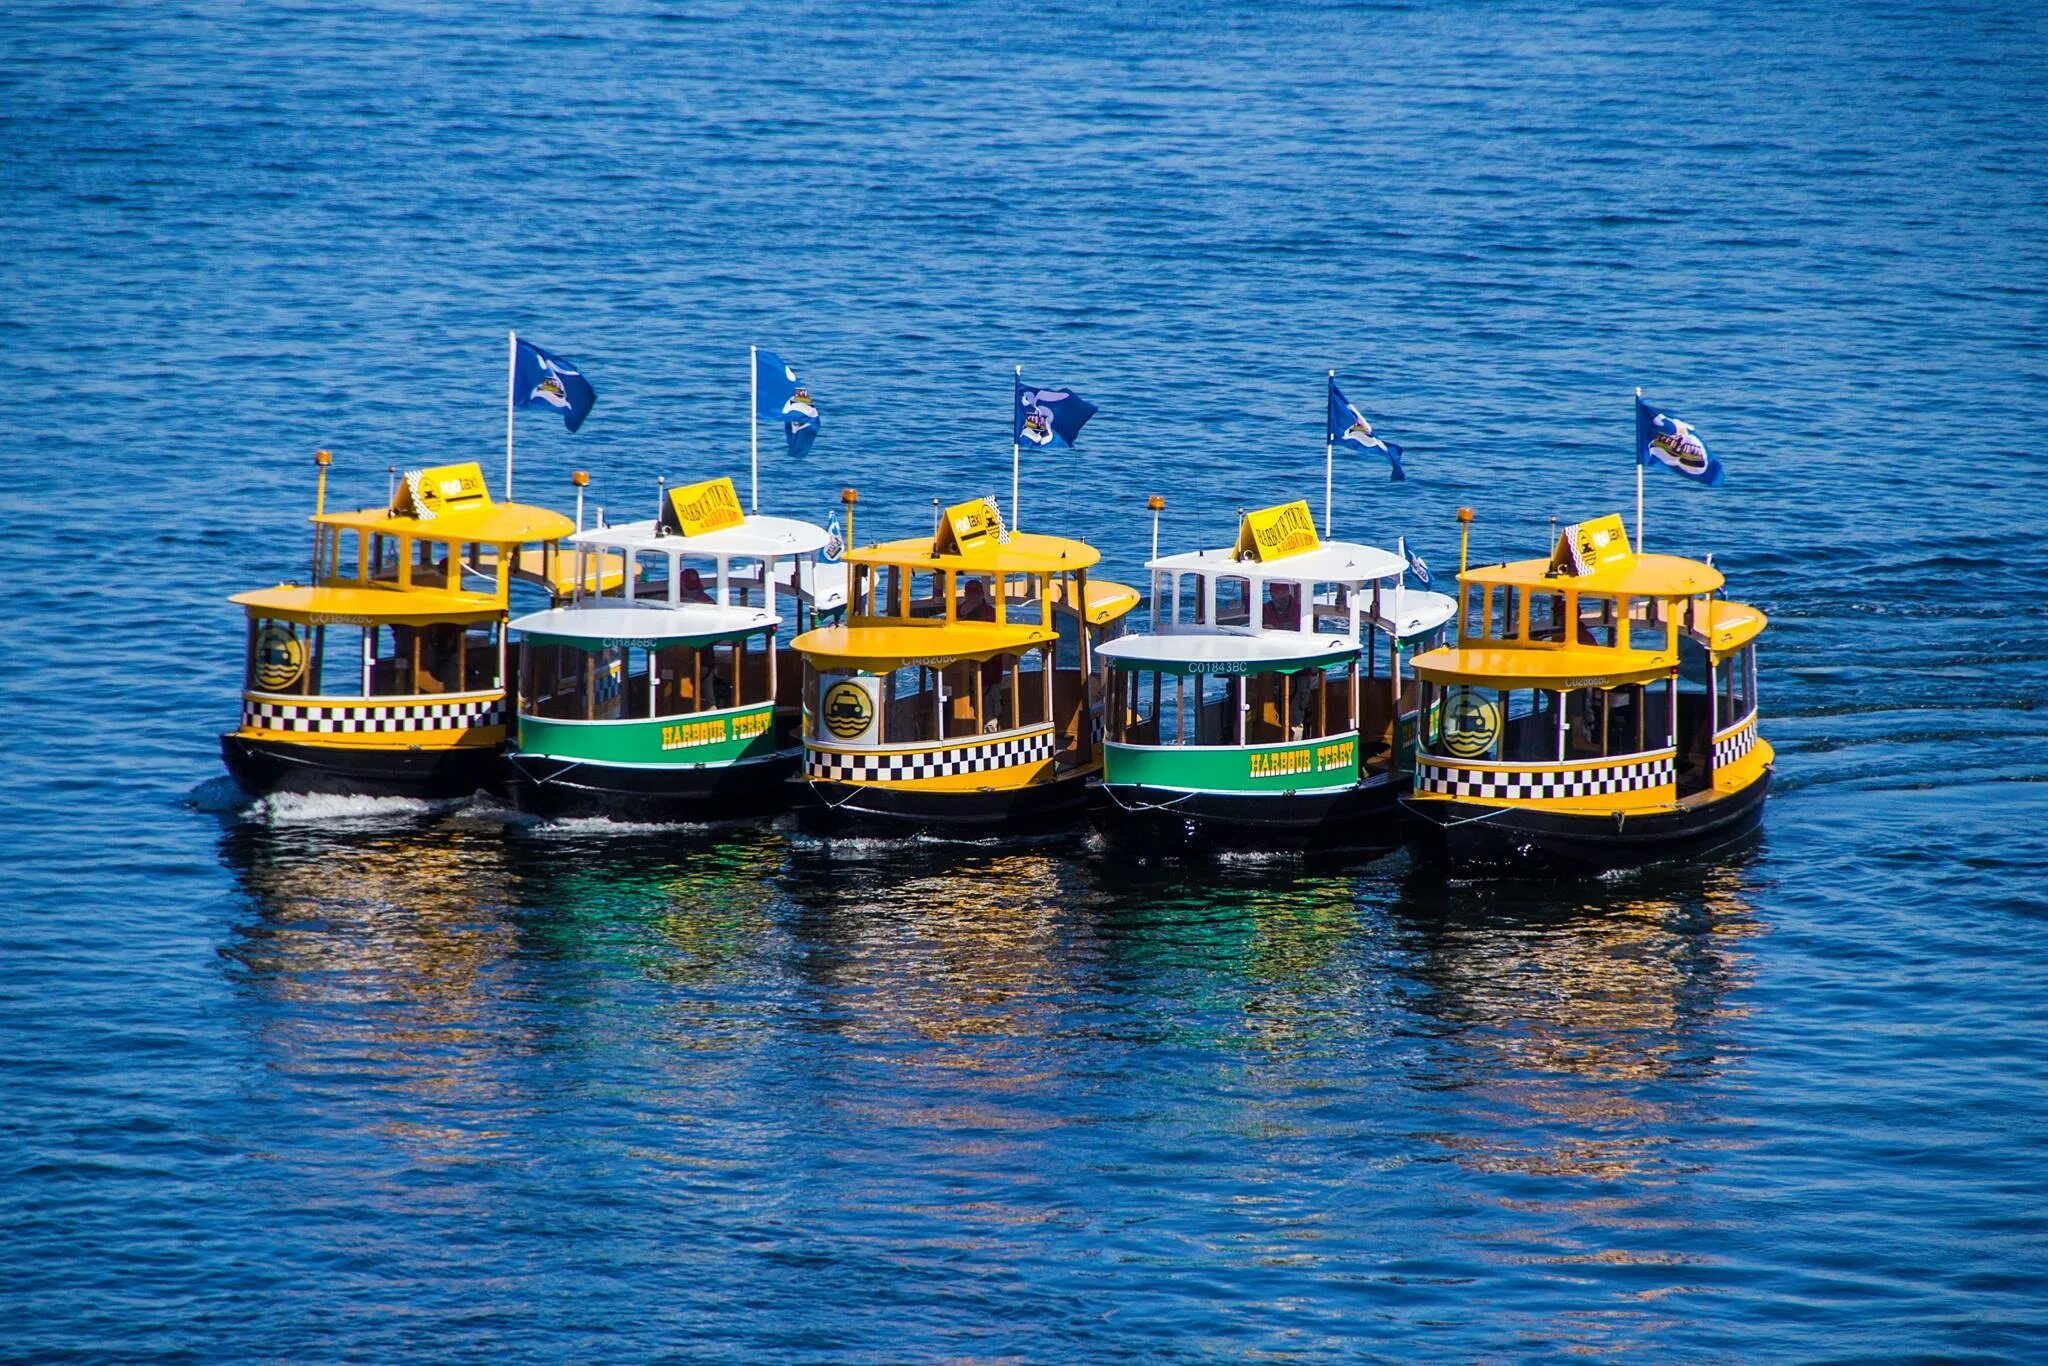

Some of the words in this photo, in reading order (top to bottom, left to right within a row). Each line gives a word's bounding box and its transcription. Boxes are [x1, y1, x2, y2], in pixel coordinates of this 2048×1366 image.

[1255, 514, 1289, 547] HARBOUR
[1188, 661, 1248, 673] C01843BC
[661, 719, 727, 751] HARBOUR
[731, 711, 771, 741] FERRY
[1249, 749, 1312, 778] HARBOUR
[1316, 741, 1354, 773] FERRY
